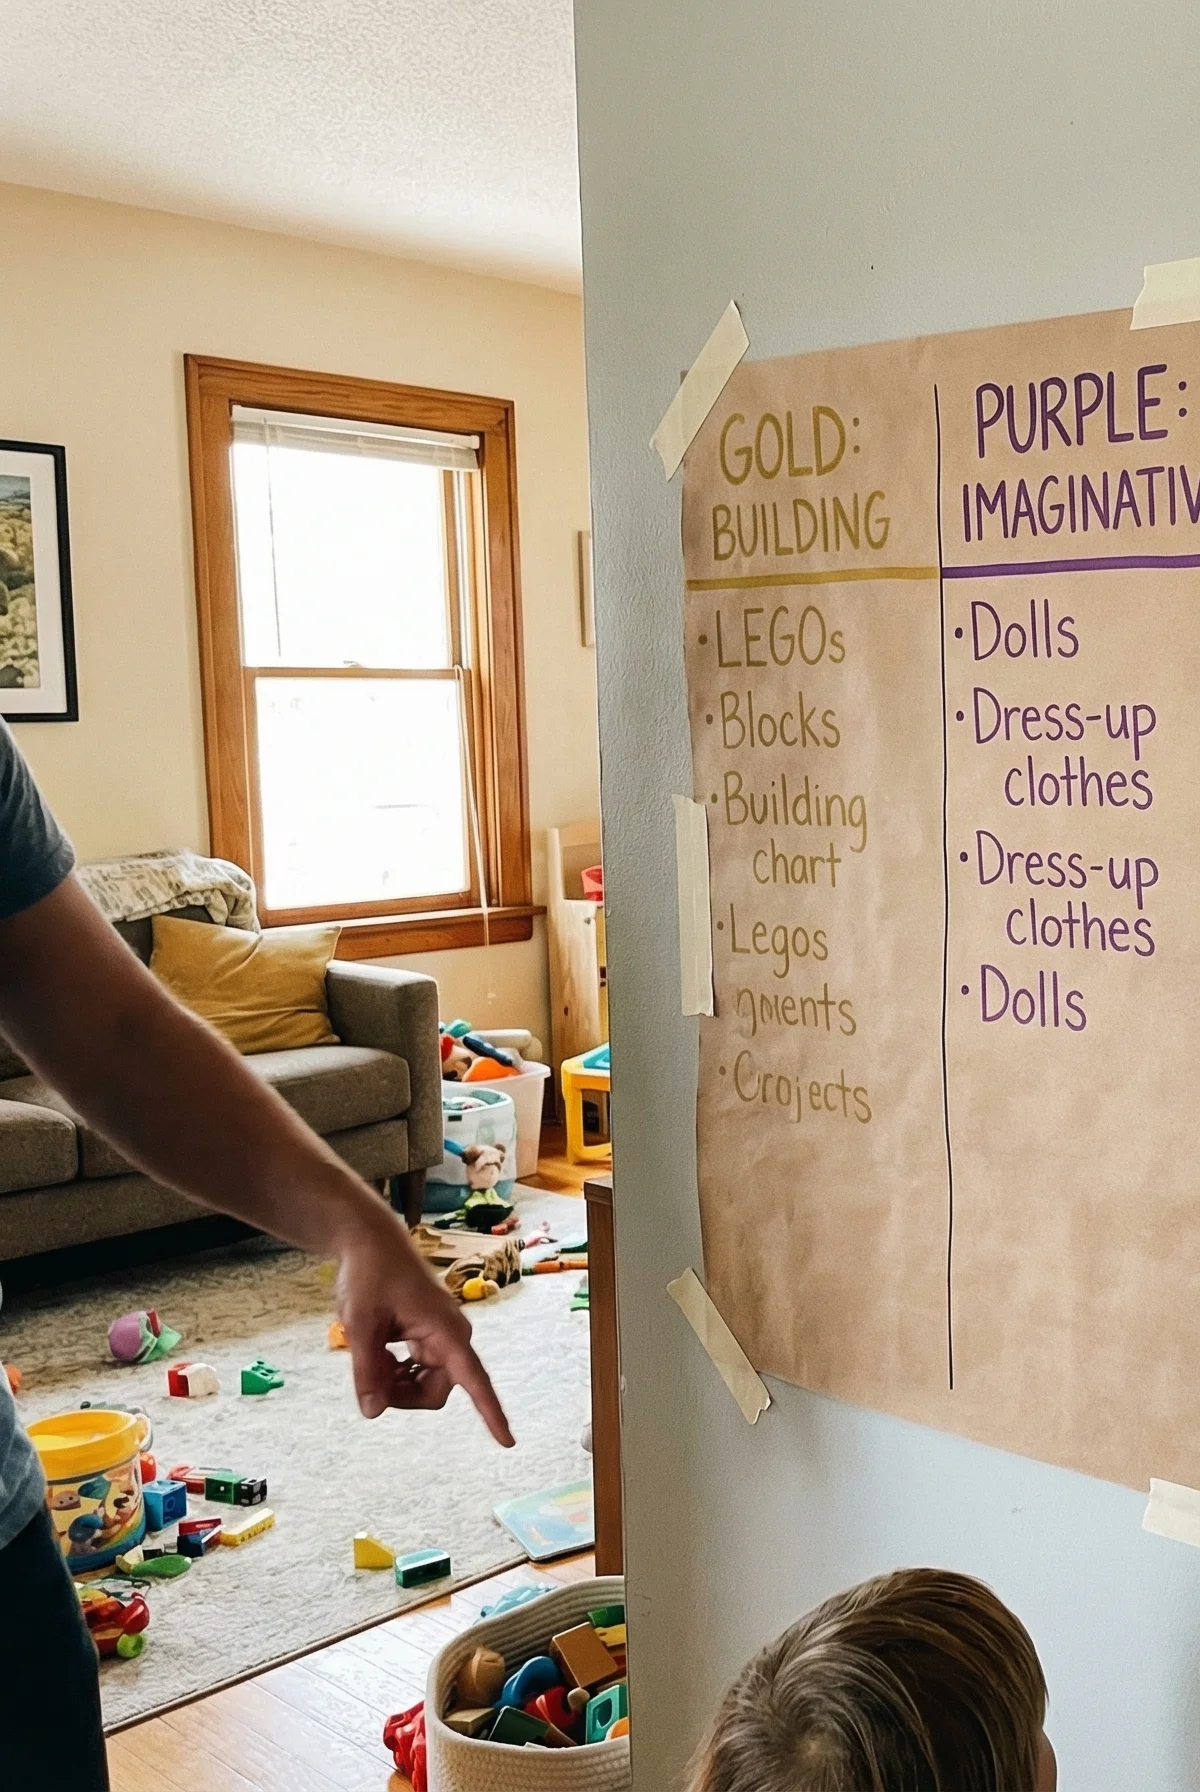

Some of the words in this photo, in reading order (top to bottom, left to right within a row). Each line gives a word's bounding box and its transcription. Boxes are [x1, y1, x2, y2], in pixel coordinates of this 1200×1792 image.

[719, 405, 861, 485] GOLD:
[976, 364, 1188, 458] PURPLE:
[712, 491, 890, 561] BUILDING
[716, 605, 846, 668] LEGOs
[971, 599, 1079, 661] Dolls
[720, 691, 841, 749] Blocks
[973, 686, 1156, 761] Dress-up
[723, 770, 867, 853] Building
[1004, 755, 1154, 811] clothes
[752, 838, 842, 888] chart
[975, 829, 1159, 910] Dress-up
[729, 903, 828, 979] Legos
[1006, 898, 1156, 957] clothes
[980, 964, 1087, 1032] Dolls
